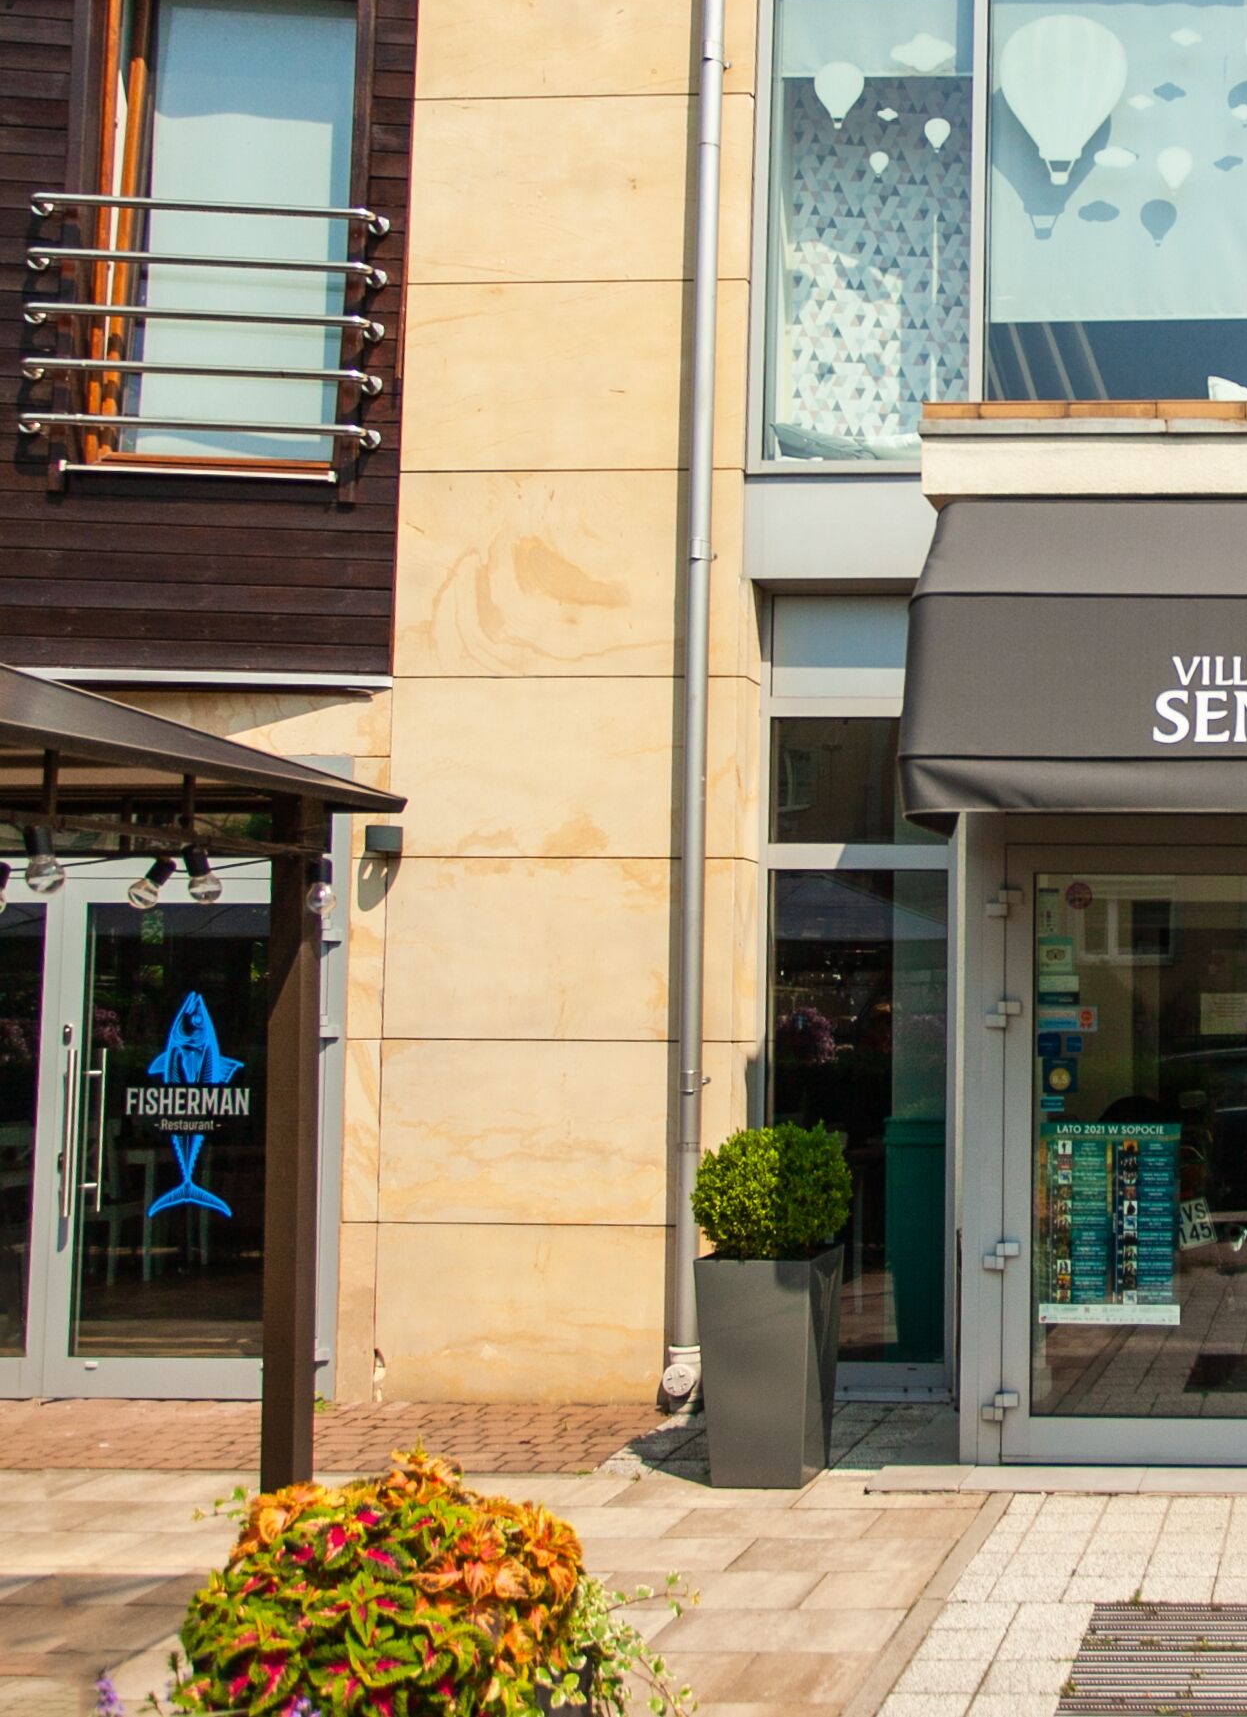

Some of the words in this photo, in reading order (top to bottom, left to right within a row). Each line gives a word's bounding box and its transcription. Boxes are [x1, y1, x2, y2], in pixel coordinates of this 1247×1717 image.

[126, 1087, 250, 1116] FISHERMAN
[160, 1118, 214, 1131] Restaurant
[1056, 1124, 1082, 1135] LATO
[1084, 1124, 1106, 1135] 2021
[1108, 1125, 1119, 1135] W
[1121, 1125, 1165, 1135] SOPOCIE
